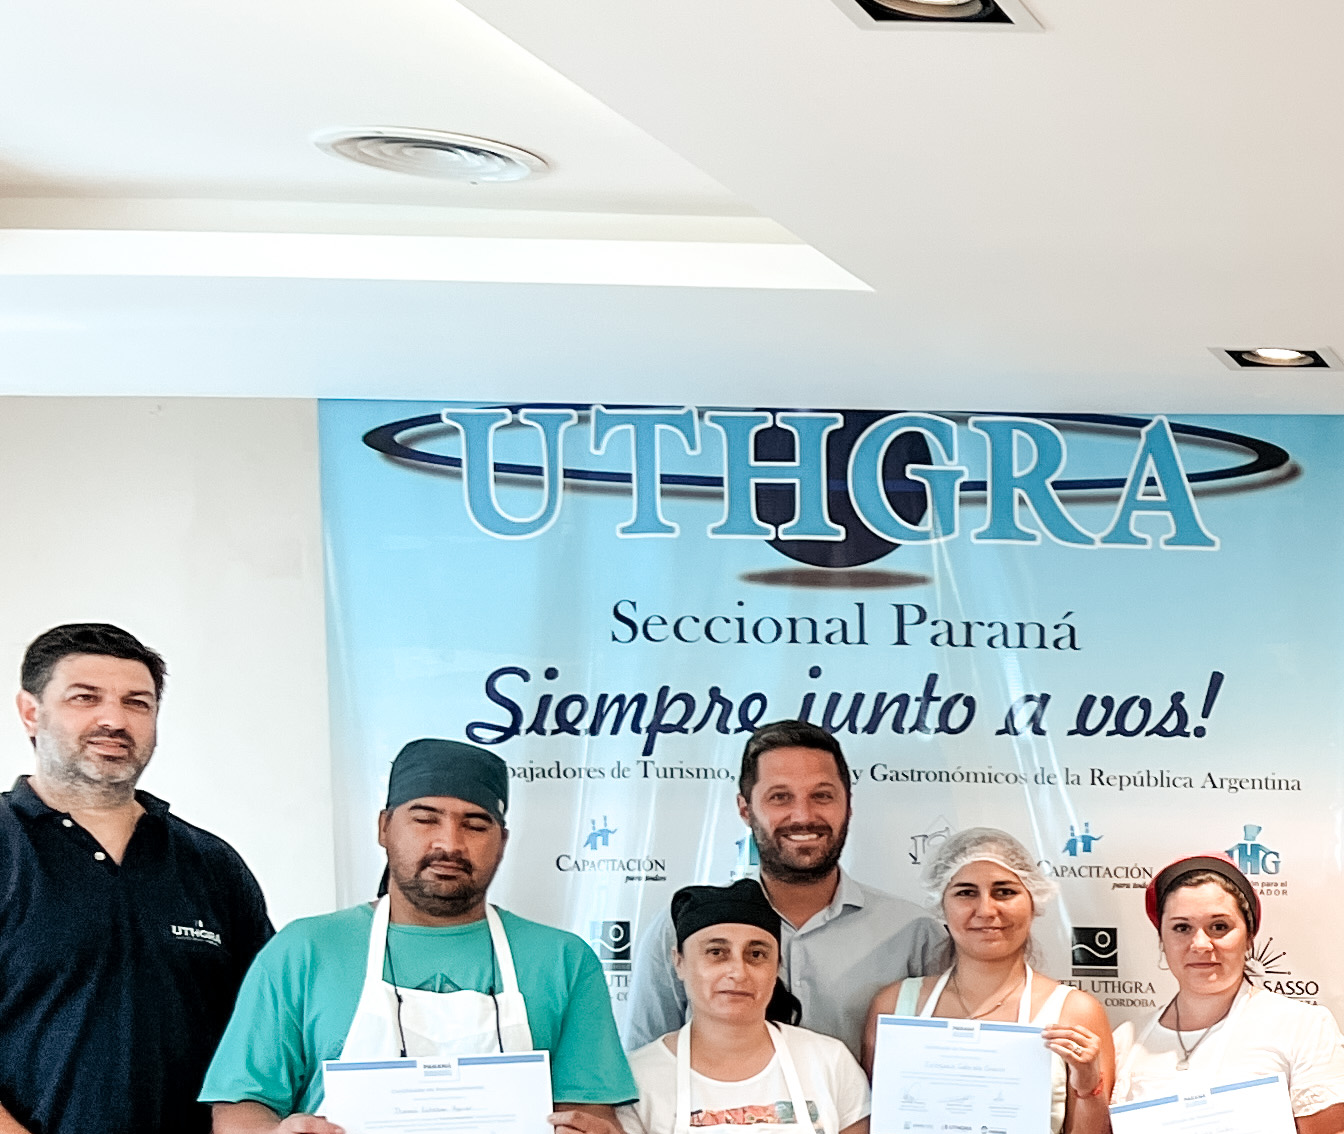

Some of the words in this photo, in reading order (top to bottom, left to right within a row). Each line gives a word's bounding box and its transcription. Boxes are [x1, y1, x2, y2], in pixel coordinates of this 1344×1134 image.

[439, 402, 1221, 551] UTHGRA
[609, 600, 868, 646] Seccional
[889, 603, 1081, 652] Paraná
[465, 666, 768, 757] Siempre
[996, 687, 1047, 736] a
[1067, 671, 1225, 739] vos!
[611, 761, 632, 779] de
[637, 760, 736, 781] Turismo,
[851, 768, 863, 785] y
[869, 763, 1028, 786] Gastronómicos
[1034, 766, 1057, 786] de
[1064, 767, 1081, 787] la
[1089, 768, 1194, 791] República
[1200, 772, 1302, 794] Argentina
[1091, 980, 1156, 994] UTHGRA
[1104, 997, 1157, 1008] CORDOBA
